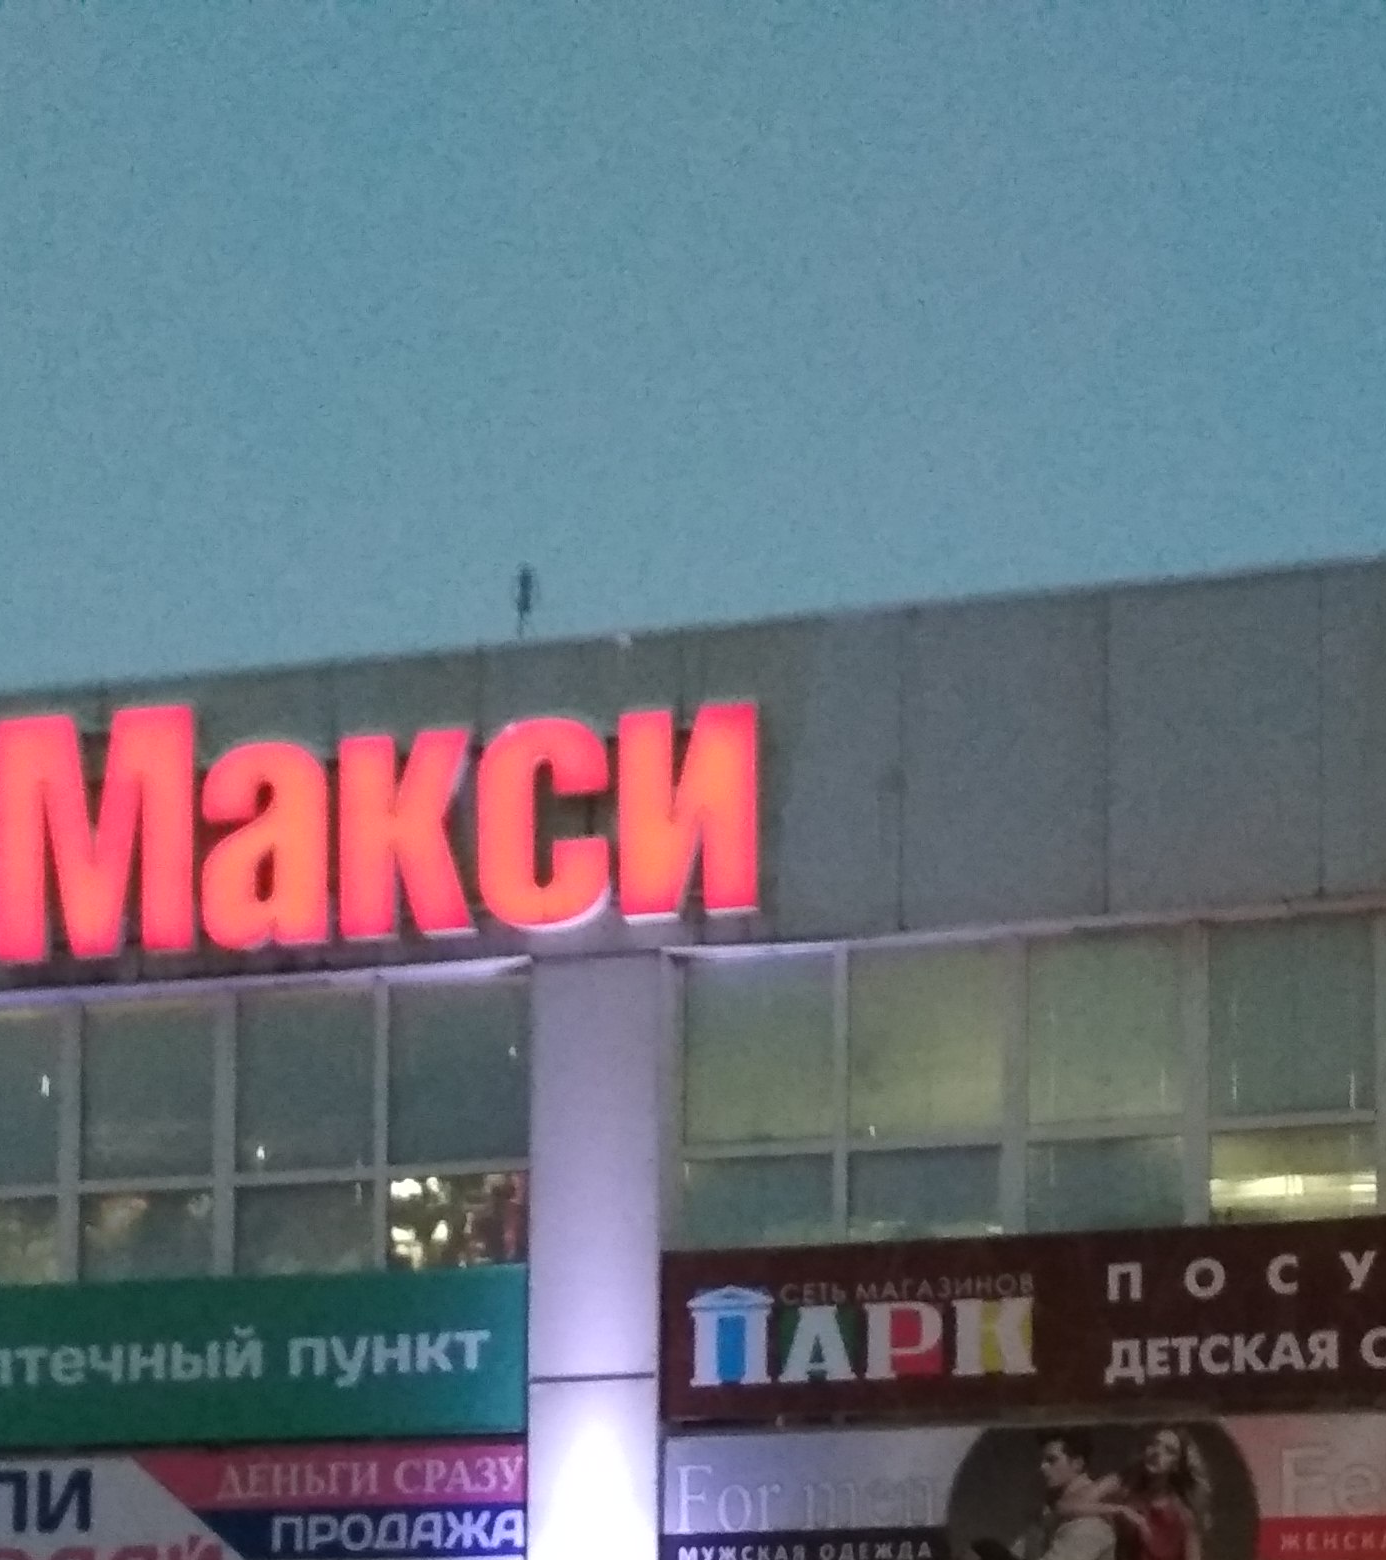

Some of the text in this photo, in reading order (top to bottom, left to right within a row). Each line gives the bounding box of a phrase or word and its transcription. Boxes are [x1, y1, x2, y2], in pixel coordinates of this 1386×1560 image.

[779, 1272, 1034, 1303] СЕТЬ МАГАЗИНОВ
[287, 1327, 490, 1378] пункт
[686, 1284, 1038, 1387] ПАРК
[1105, 1330, 1340, 1386] ДЕТСКАЯ
[216, 1454, 524, 1500] ДЕНЬГИ СРАЗУ
[677, 1464, 782, 1533] For
[271, 1509, 524, 1552] ПРОДАЖА
